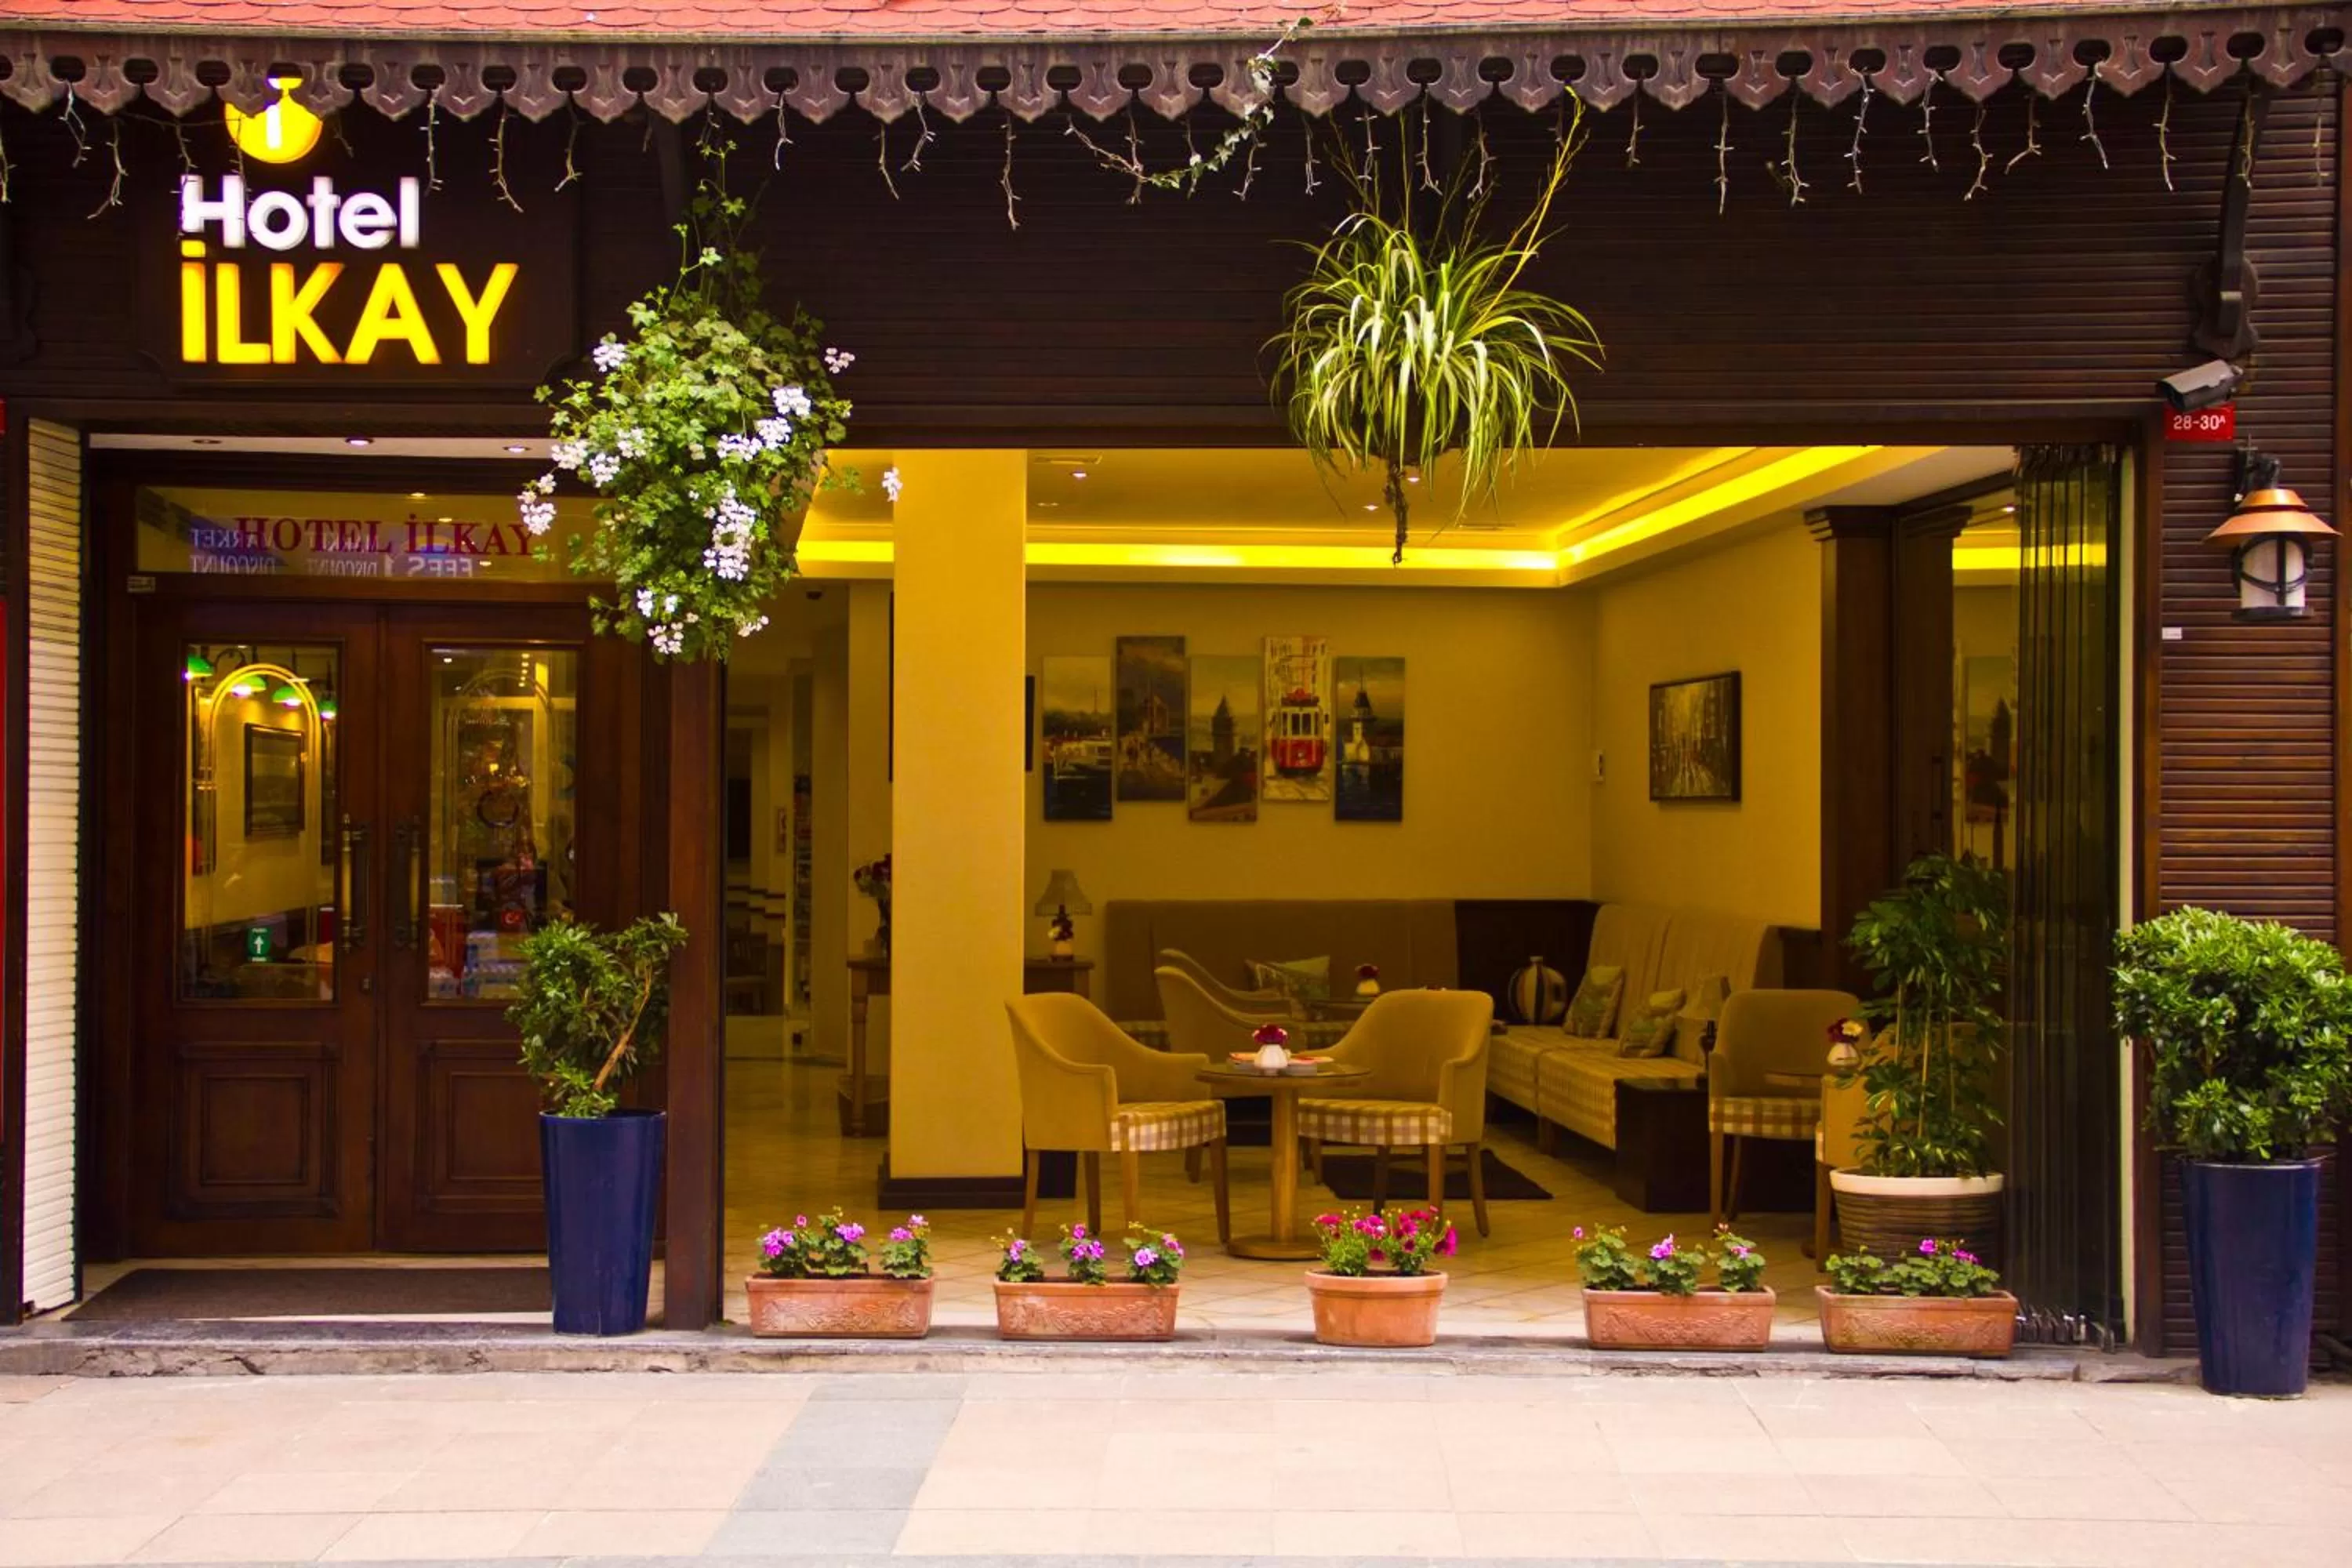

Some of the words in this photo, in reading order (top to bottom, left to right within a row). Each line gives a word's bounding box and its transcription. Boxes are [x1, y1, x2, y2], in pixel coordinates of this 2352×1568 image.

[181, 175, 419, 250] Hotel
[181, 240, 519, 364] İLKAY
[233, 517, 392, 553] HOTEL
[405, 514, 532, 555] İLKAY
